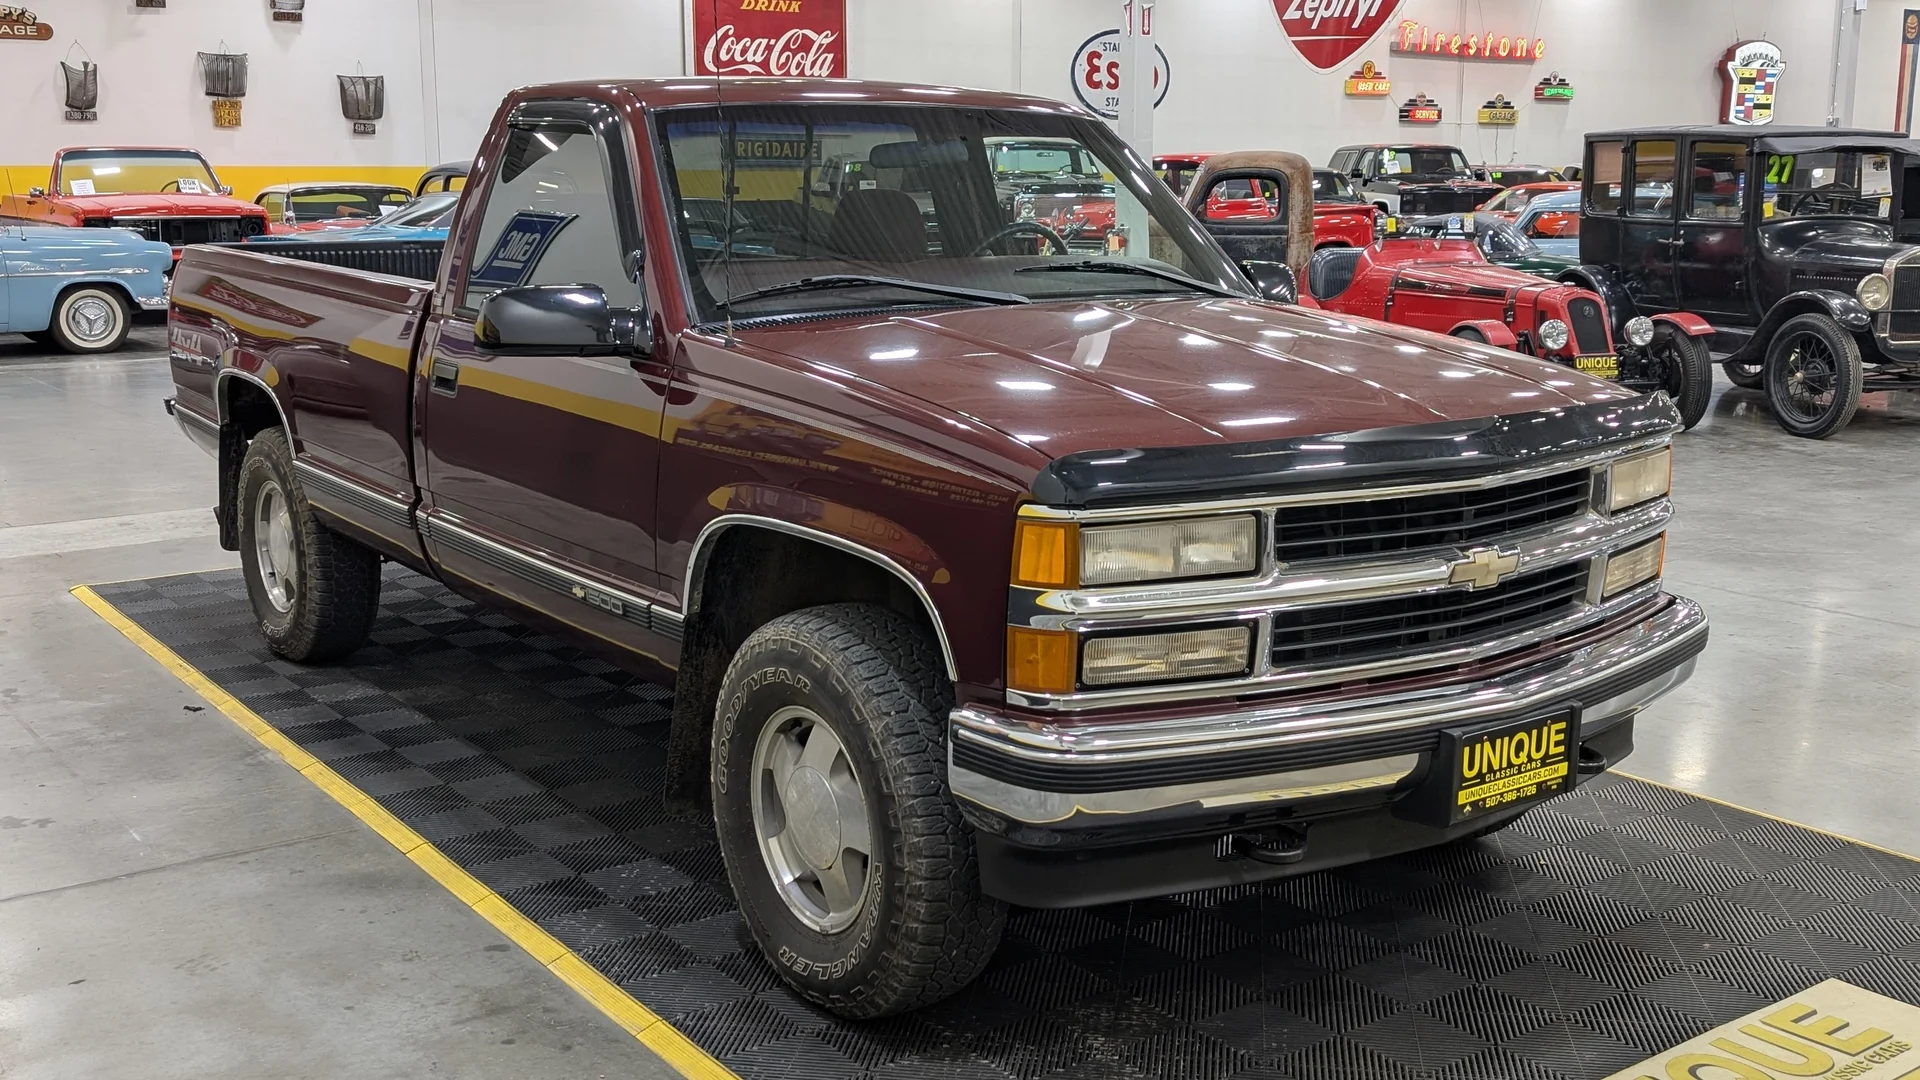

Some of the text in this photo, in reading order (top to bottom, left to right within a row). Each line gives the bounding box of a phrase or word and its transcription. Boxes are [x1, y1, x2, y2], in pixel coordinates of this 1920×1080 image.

[740, 0, 802, 13] DRINK
[704, 24, 840, 78] Coca-Cola
[1400, 20, 1545, 58] Firestone
[1356, 81, 1391, 91] USED CARS
[1415, 109, 1438, 119] SERVICE
[737, 141, 817, 157] RIGIDAIRE
[1767, 155, 1794, 184] 27
[1576, 356, 1617, 369] UNIQUE
[718, 667, 811, 794] GOODYEAR
[1462, 721, 1567, 779] UNIQUE
[1465, 766, 1560, 801] UNIQUECLASSICCARS.COM
[1485, 760, 1542, 782] CLASSIC CARS
[778, 862, 883, 980] WRANGLER
[1864, 1041, 1912, 1064] CARS
